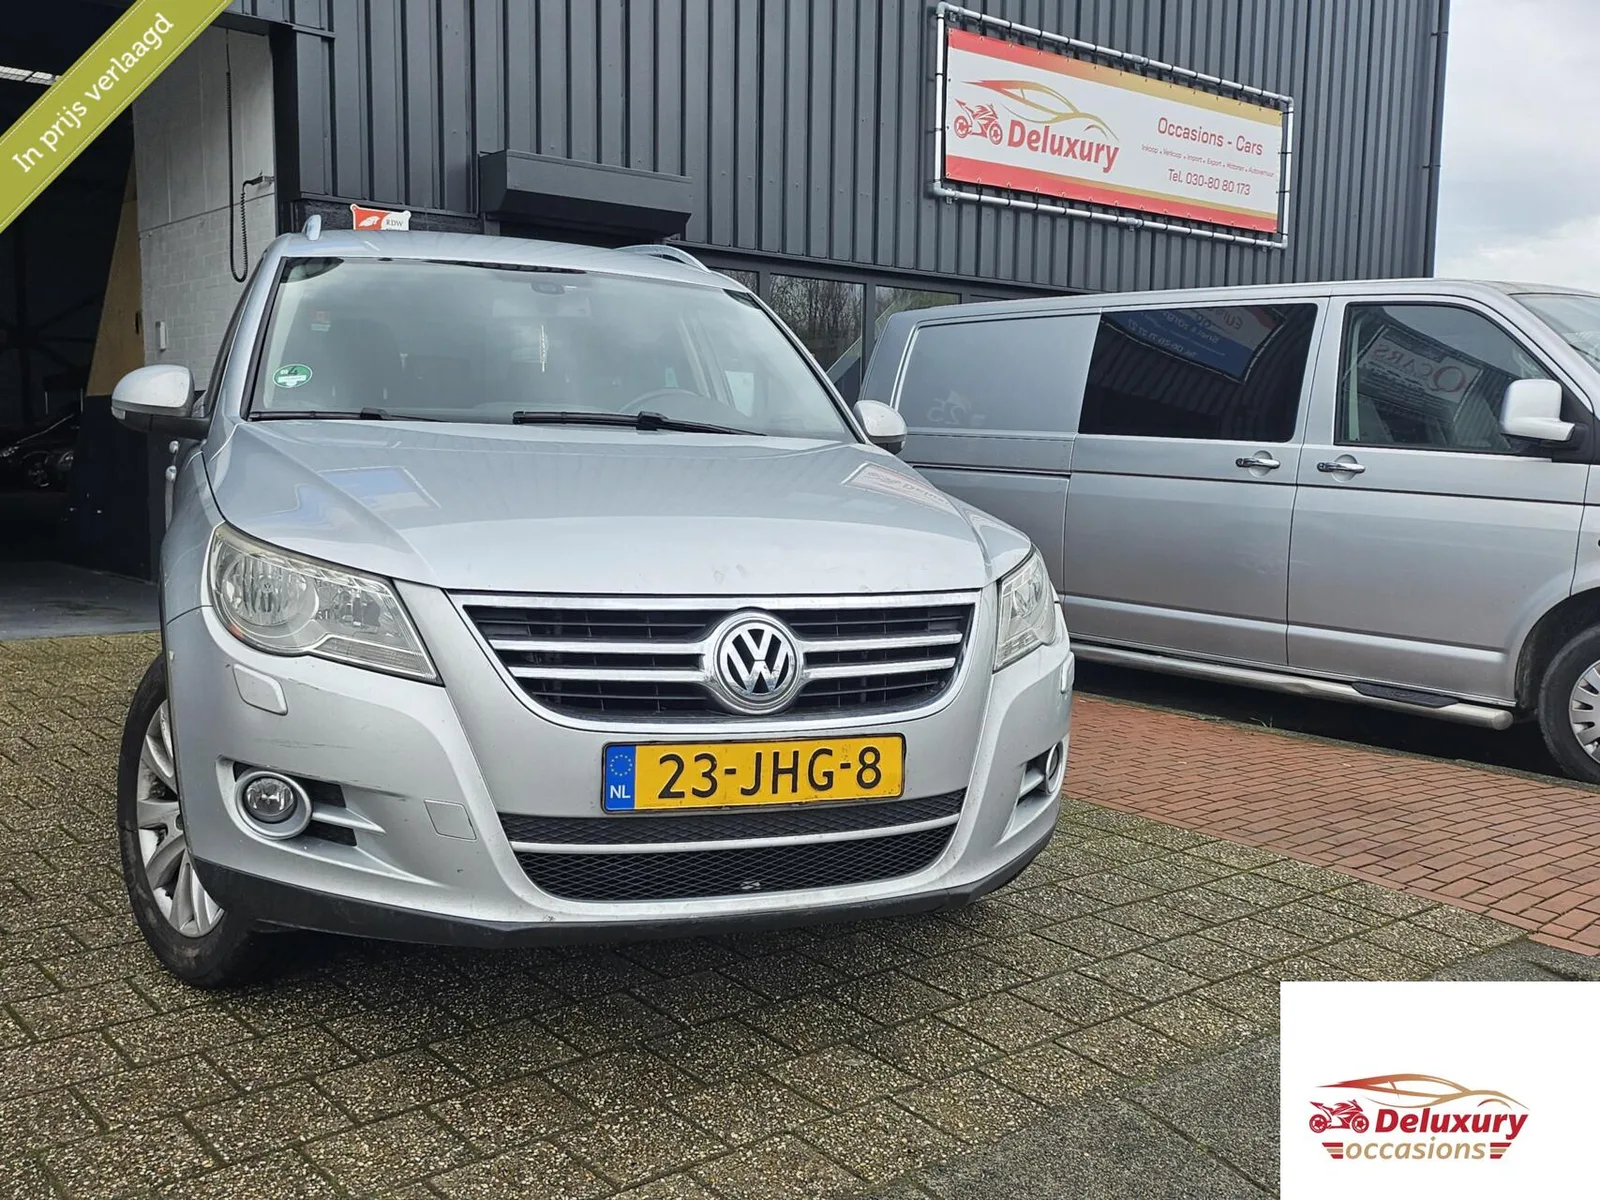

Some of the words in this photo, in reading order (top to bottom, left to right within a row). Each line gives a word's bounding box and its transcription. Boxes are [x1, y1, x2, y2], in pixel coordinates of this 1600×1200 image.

[1007, 119, 1119, 173] Deluxury
[1158, 116, 1224, 147] Occasions
[1236, 135, 1264, 156] Cars
[1168, 168, 1183, 183] Tel.
[1186, 172, 1220, 190] 030-80
[1221, 179, 1235, 193] 80
[1236, 182, 1251, 196] 173
[386, 219, 404, 227] RDW
[724, 625, 793, 696] VW
[609, 784, 631, 799] NL
[658, 746, 882, 799] 23-JHG-8
